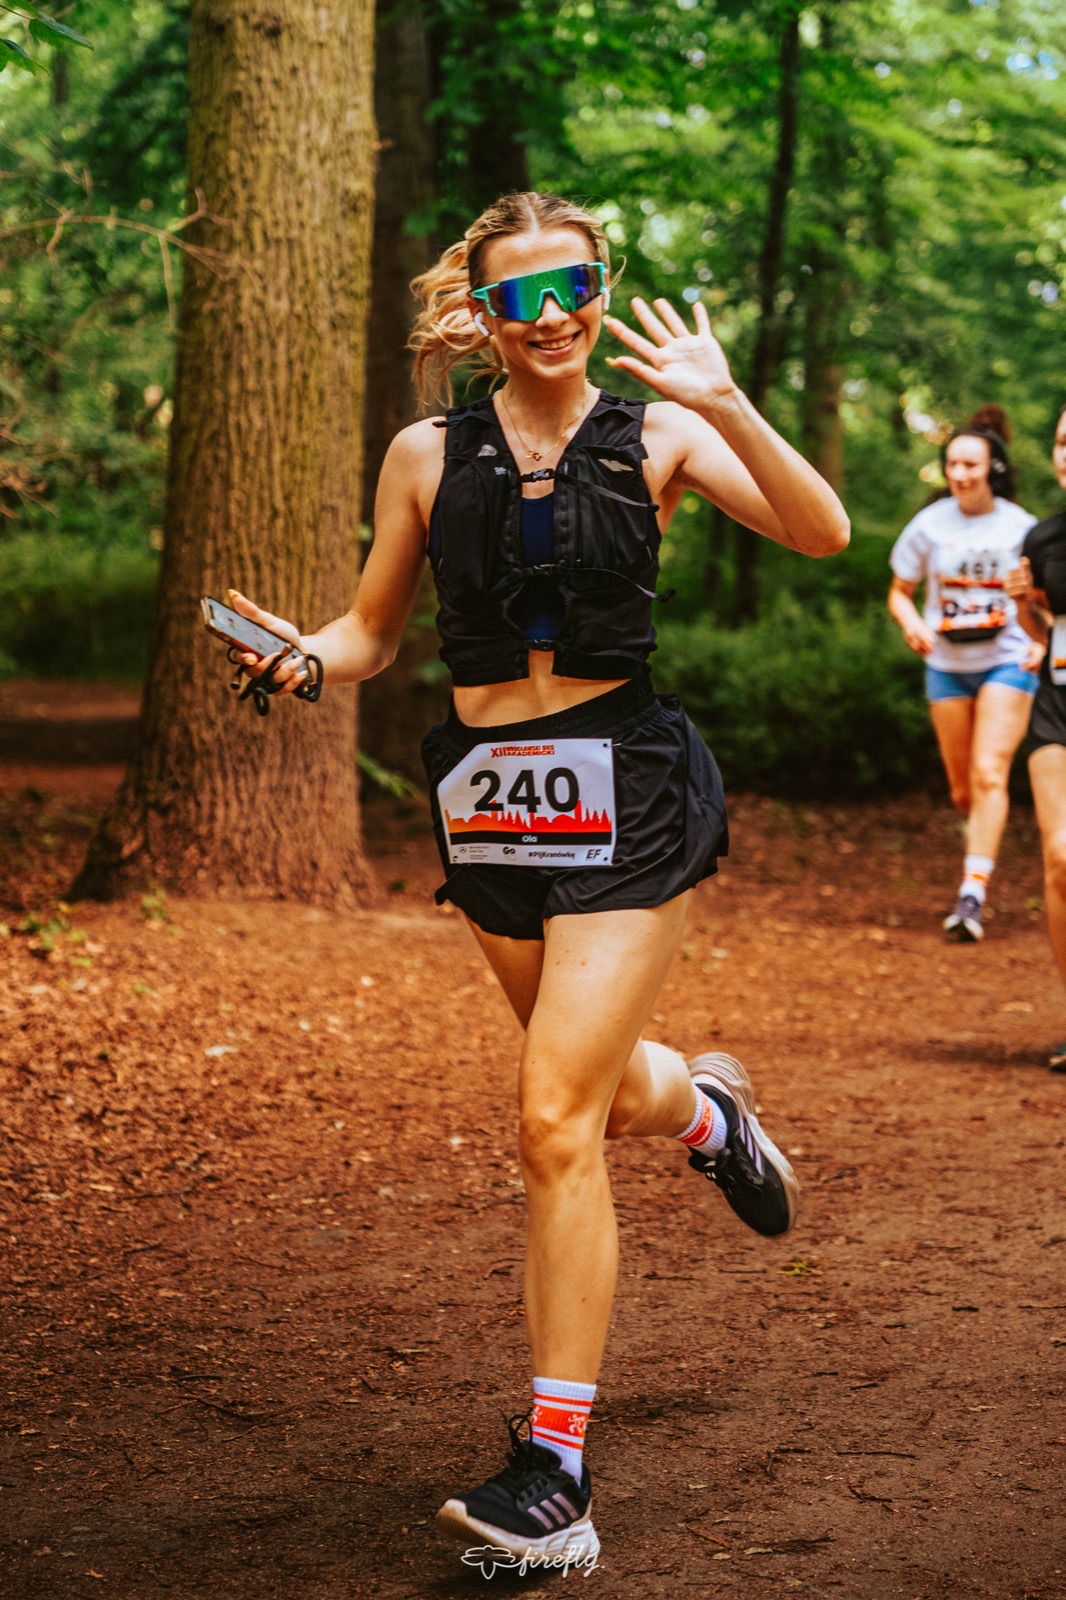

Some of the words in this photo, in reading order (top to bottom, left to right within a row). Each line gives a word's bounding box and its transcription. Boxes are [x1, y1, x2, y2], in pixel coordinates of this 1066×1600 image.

[470, 767, 580, 813] 240
[522, 835, 538, 843] Ola
[585, 849, 602, 860] EF
